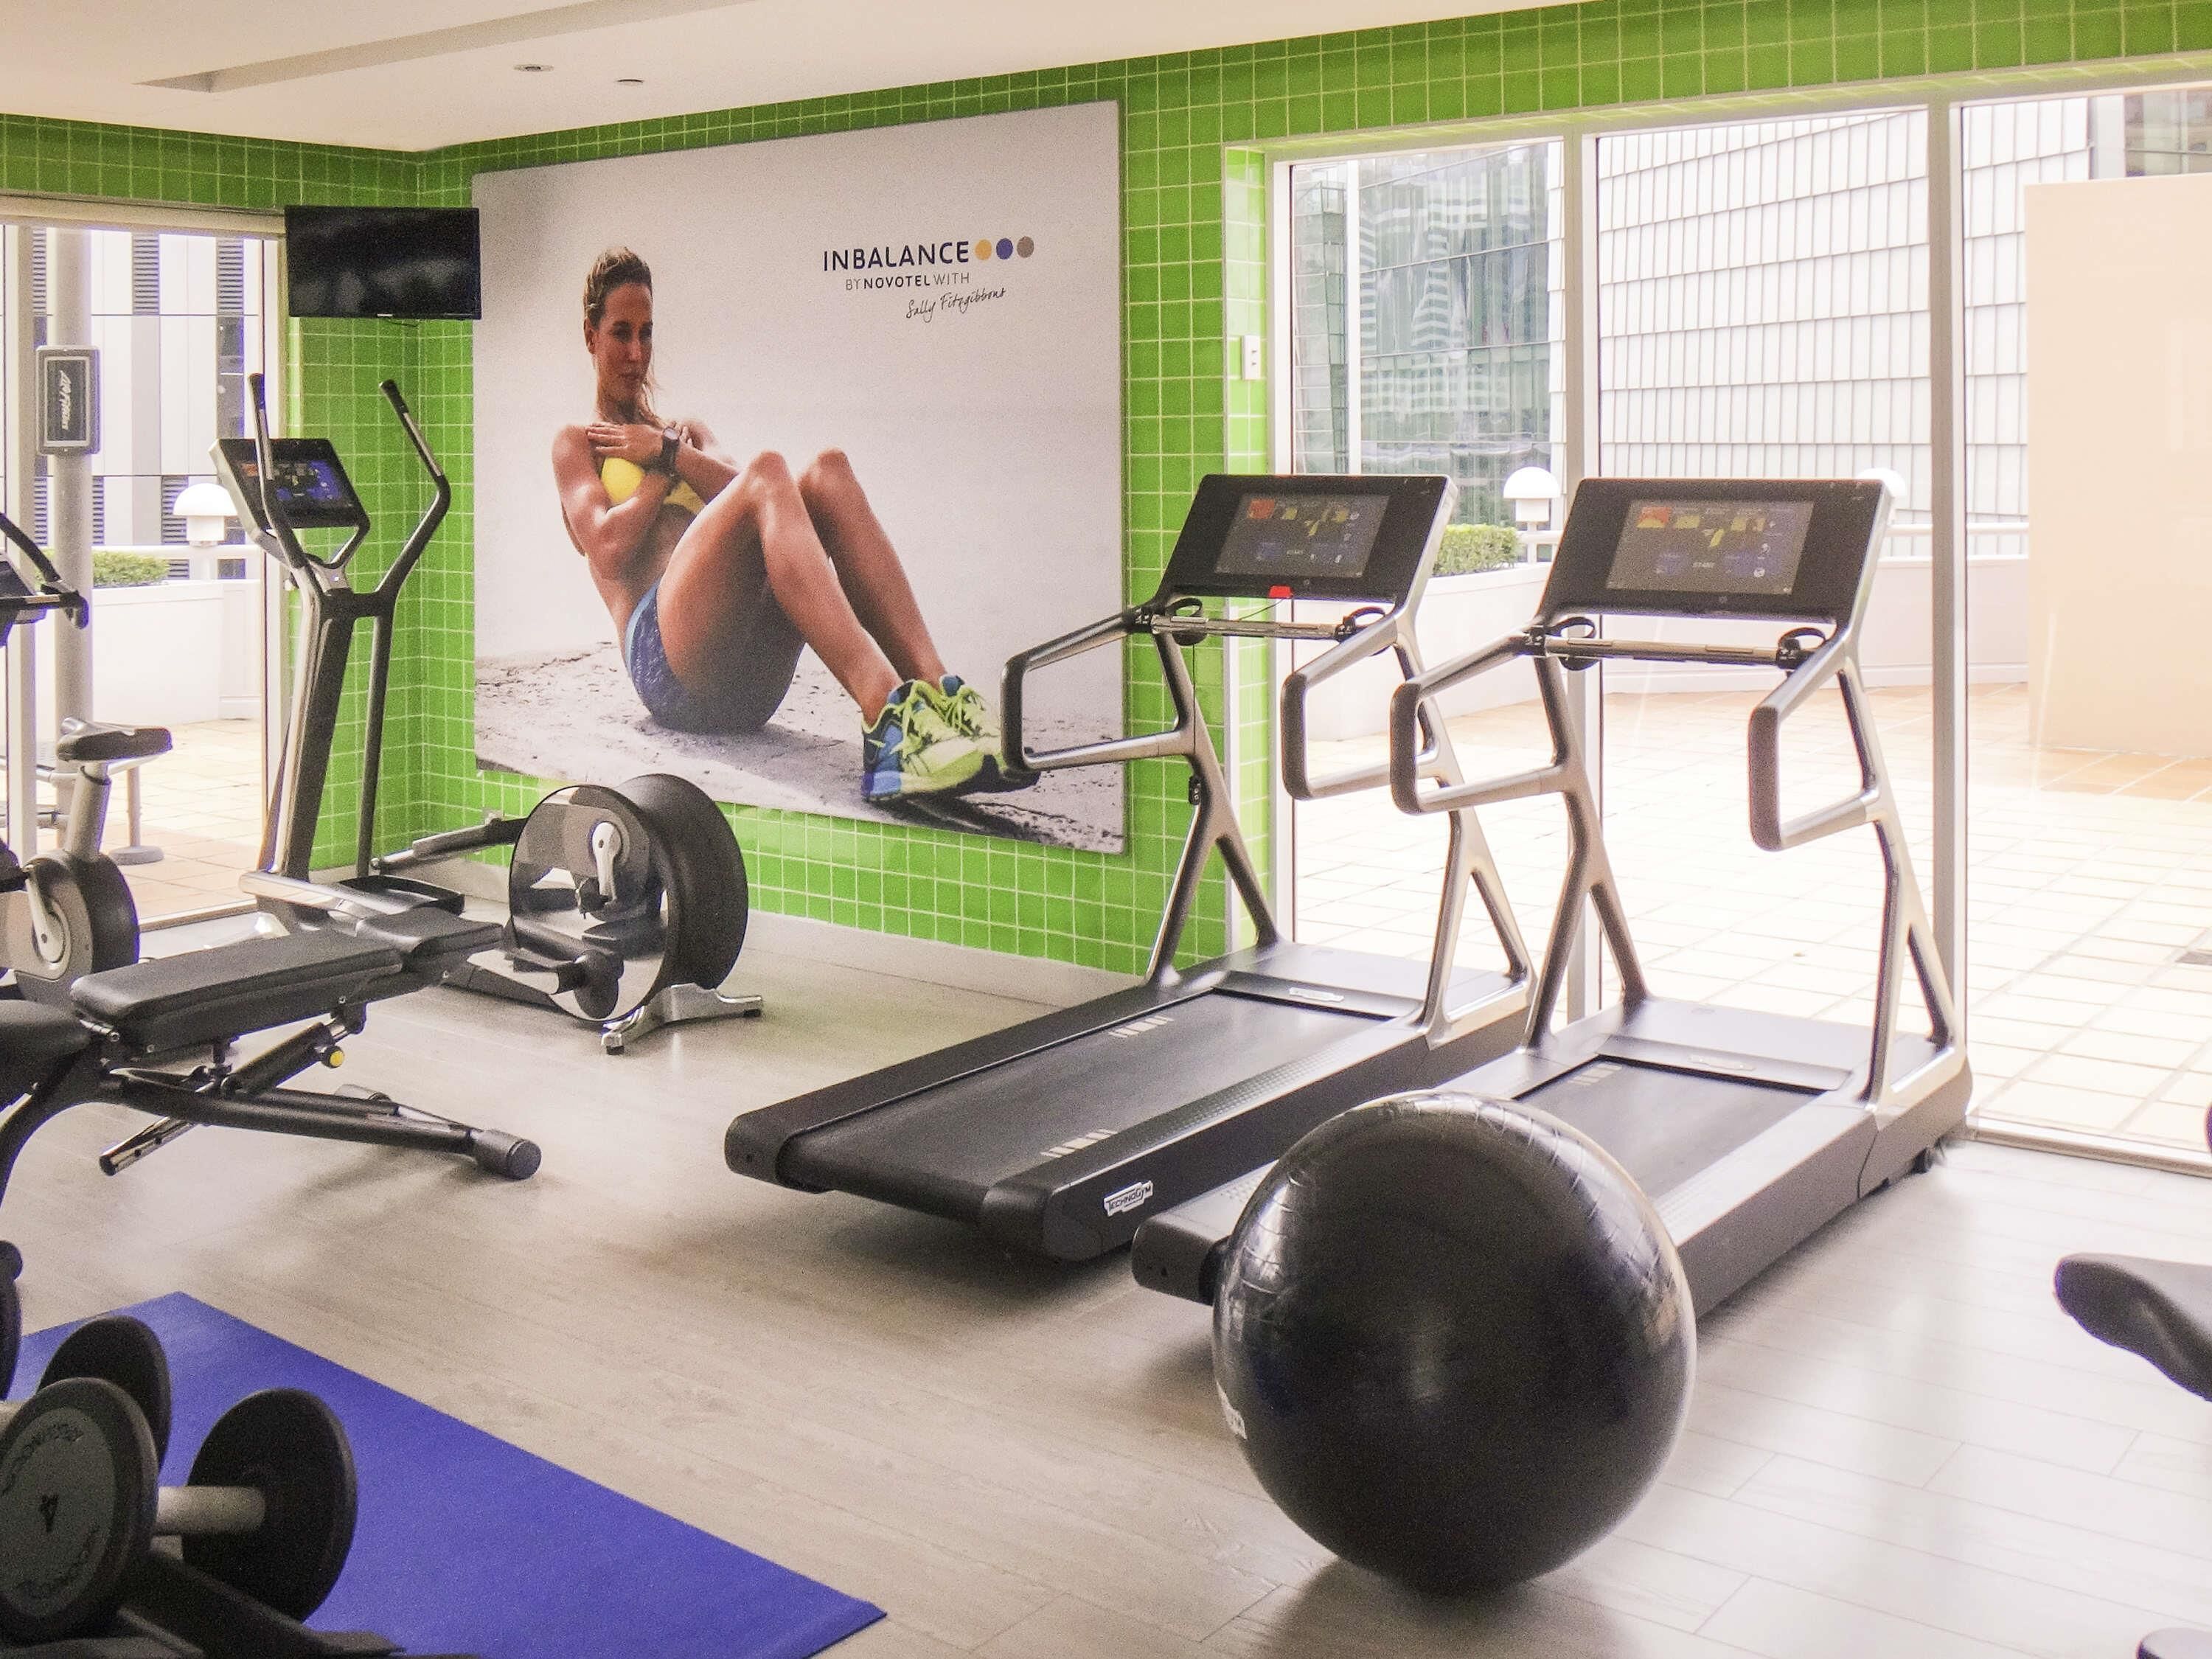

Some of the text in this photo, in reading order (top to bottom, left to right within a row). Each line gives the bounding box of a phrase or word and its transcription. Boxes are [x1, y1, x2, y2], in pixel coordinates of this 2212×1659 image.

[824, 240, 969, 271] INBALANCE
[846, 272, 970, 291] BY NOVOTEL WITH
[906, 299, 936, 323] Sally
